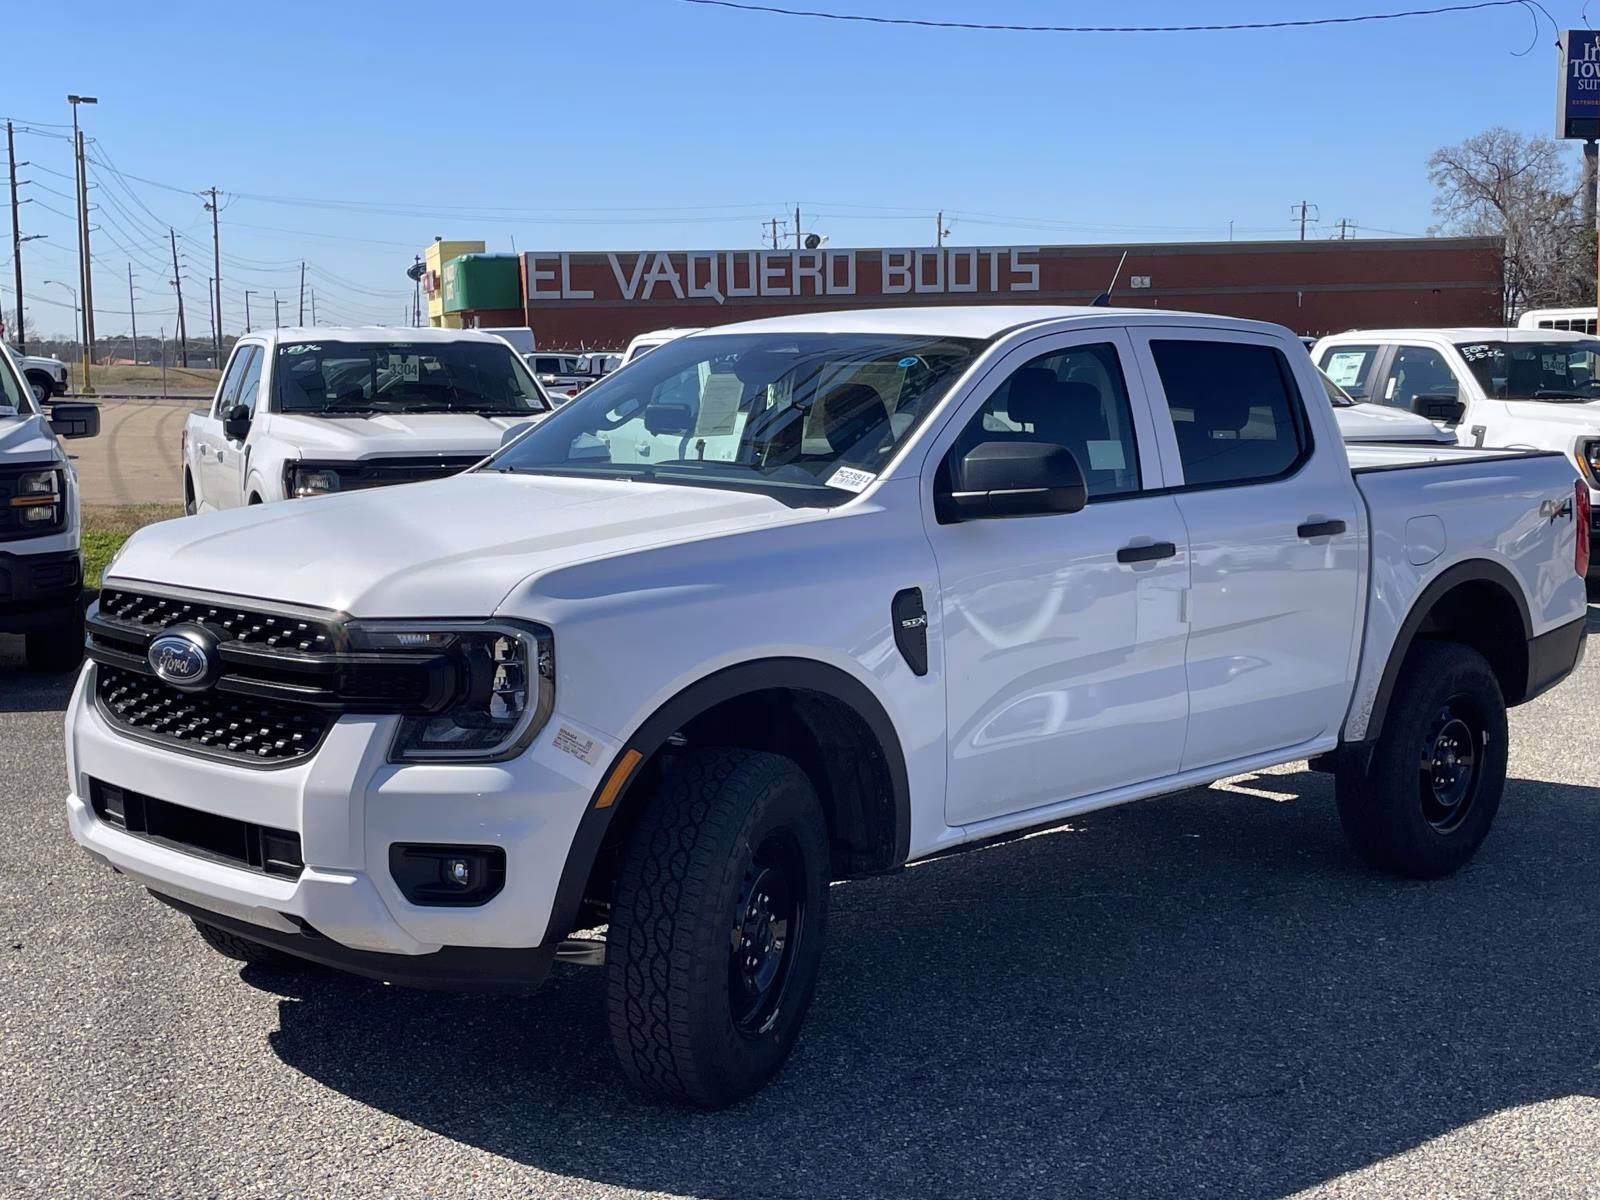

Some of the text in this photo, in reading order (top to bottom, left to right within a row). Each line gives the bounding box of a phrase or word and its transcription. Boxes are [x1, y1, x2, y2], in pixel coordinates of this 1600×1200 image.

[1570, 59, 1600, 78] To
[528, 247, 1040, 305] EL VAQUERO BOOTS
[390, 363, 417, 376] 3304
[159, 646, 191, 673] Ford
